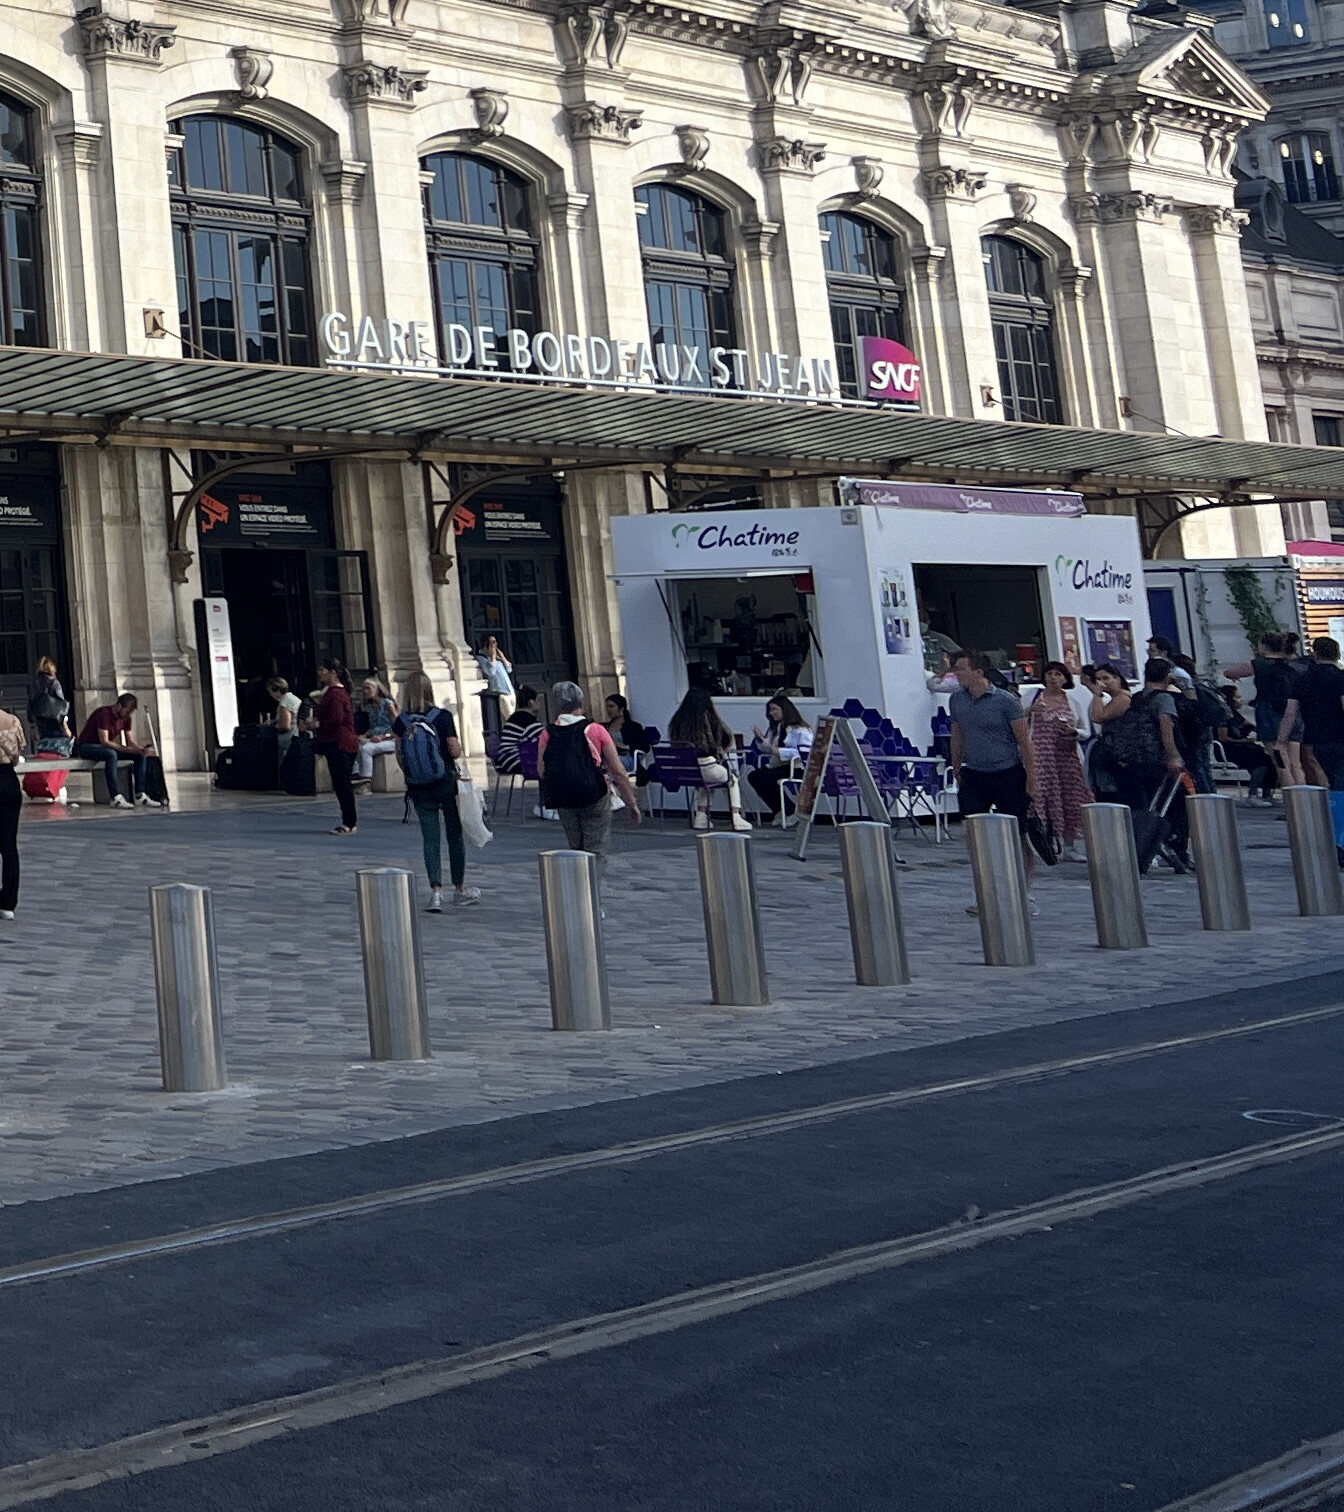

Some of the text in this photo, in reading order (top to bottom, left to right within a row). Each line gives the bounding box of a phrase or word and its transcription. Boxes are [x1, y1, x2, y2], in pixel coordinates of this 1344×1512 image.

[321, 312, 837, 392] GARE DE BORDEAUX ST JEAN
[870, 360, 920, 392] SNCF
[698, 523, 800, 549] Chatime
[1072, 559, 1132, 590] Chatime
